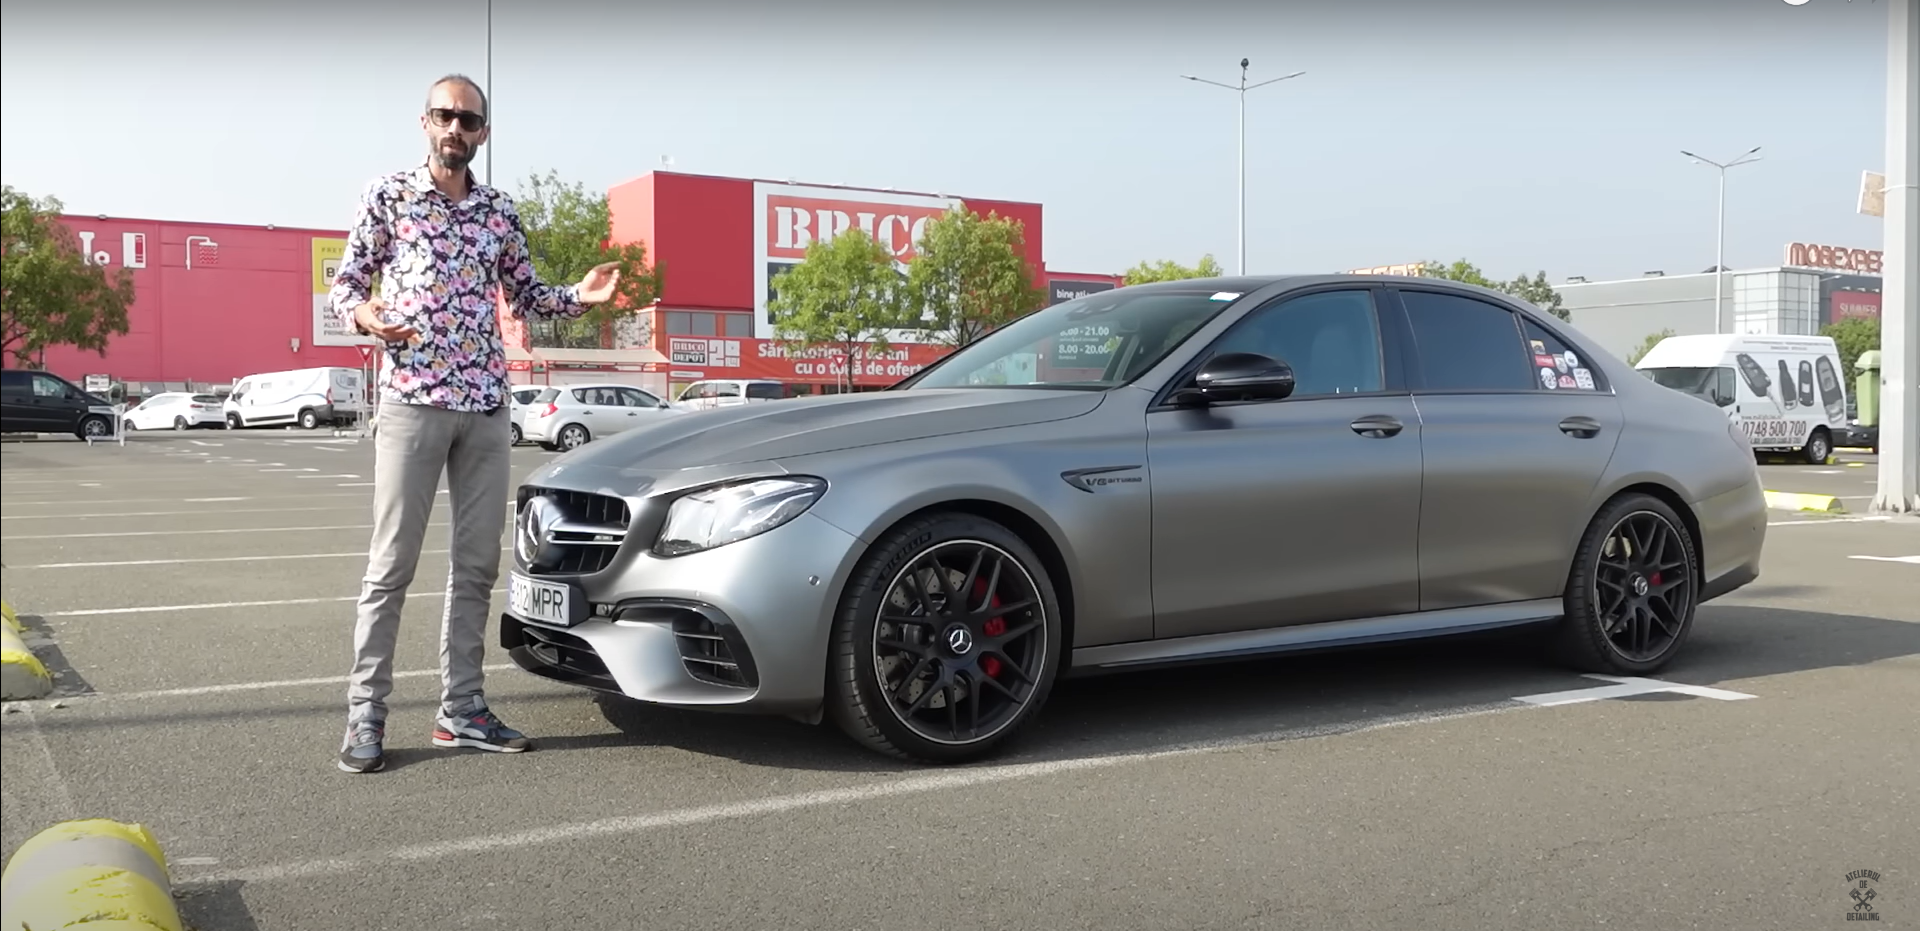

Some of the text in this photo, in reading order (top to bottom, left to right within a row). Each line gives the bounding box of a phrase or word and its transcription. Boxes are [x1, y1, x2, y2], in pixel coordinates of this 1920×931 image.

[1789, 242, 1883, 273] MOBEXPE
[673, 342, 705, 351] BRICO
[795, 363, 813, 374] cu
[816, 363, 826, 375] o
[866, 362, 884, 375] de
[887, 362, 924, 376] ofert
[1742, 420, 1807, 437] 0748 500 700
[532, 586, 564, 619] MPR
